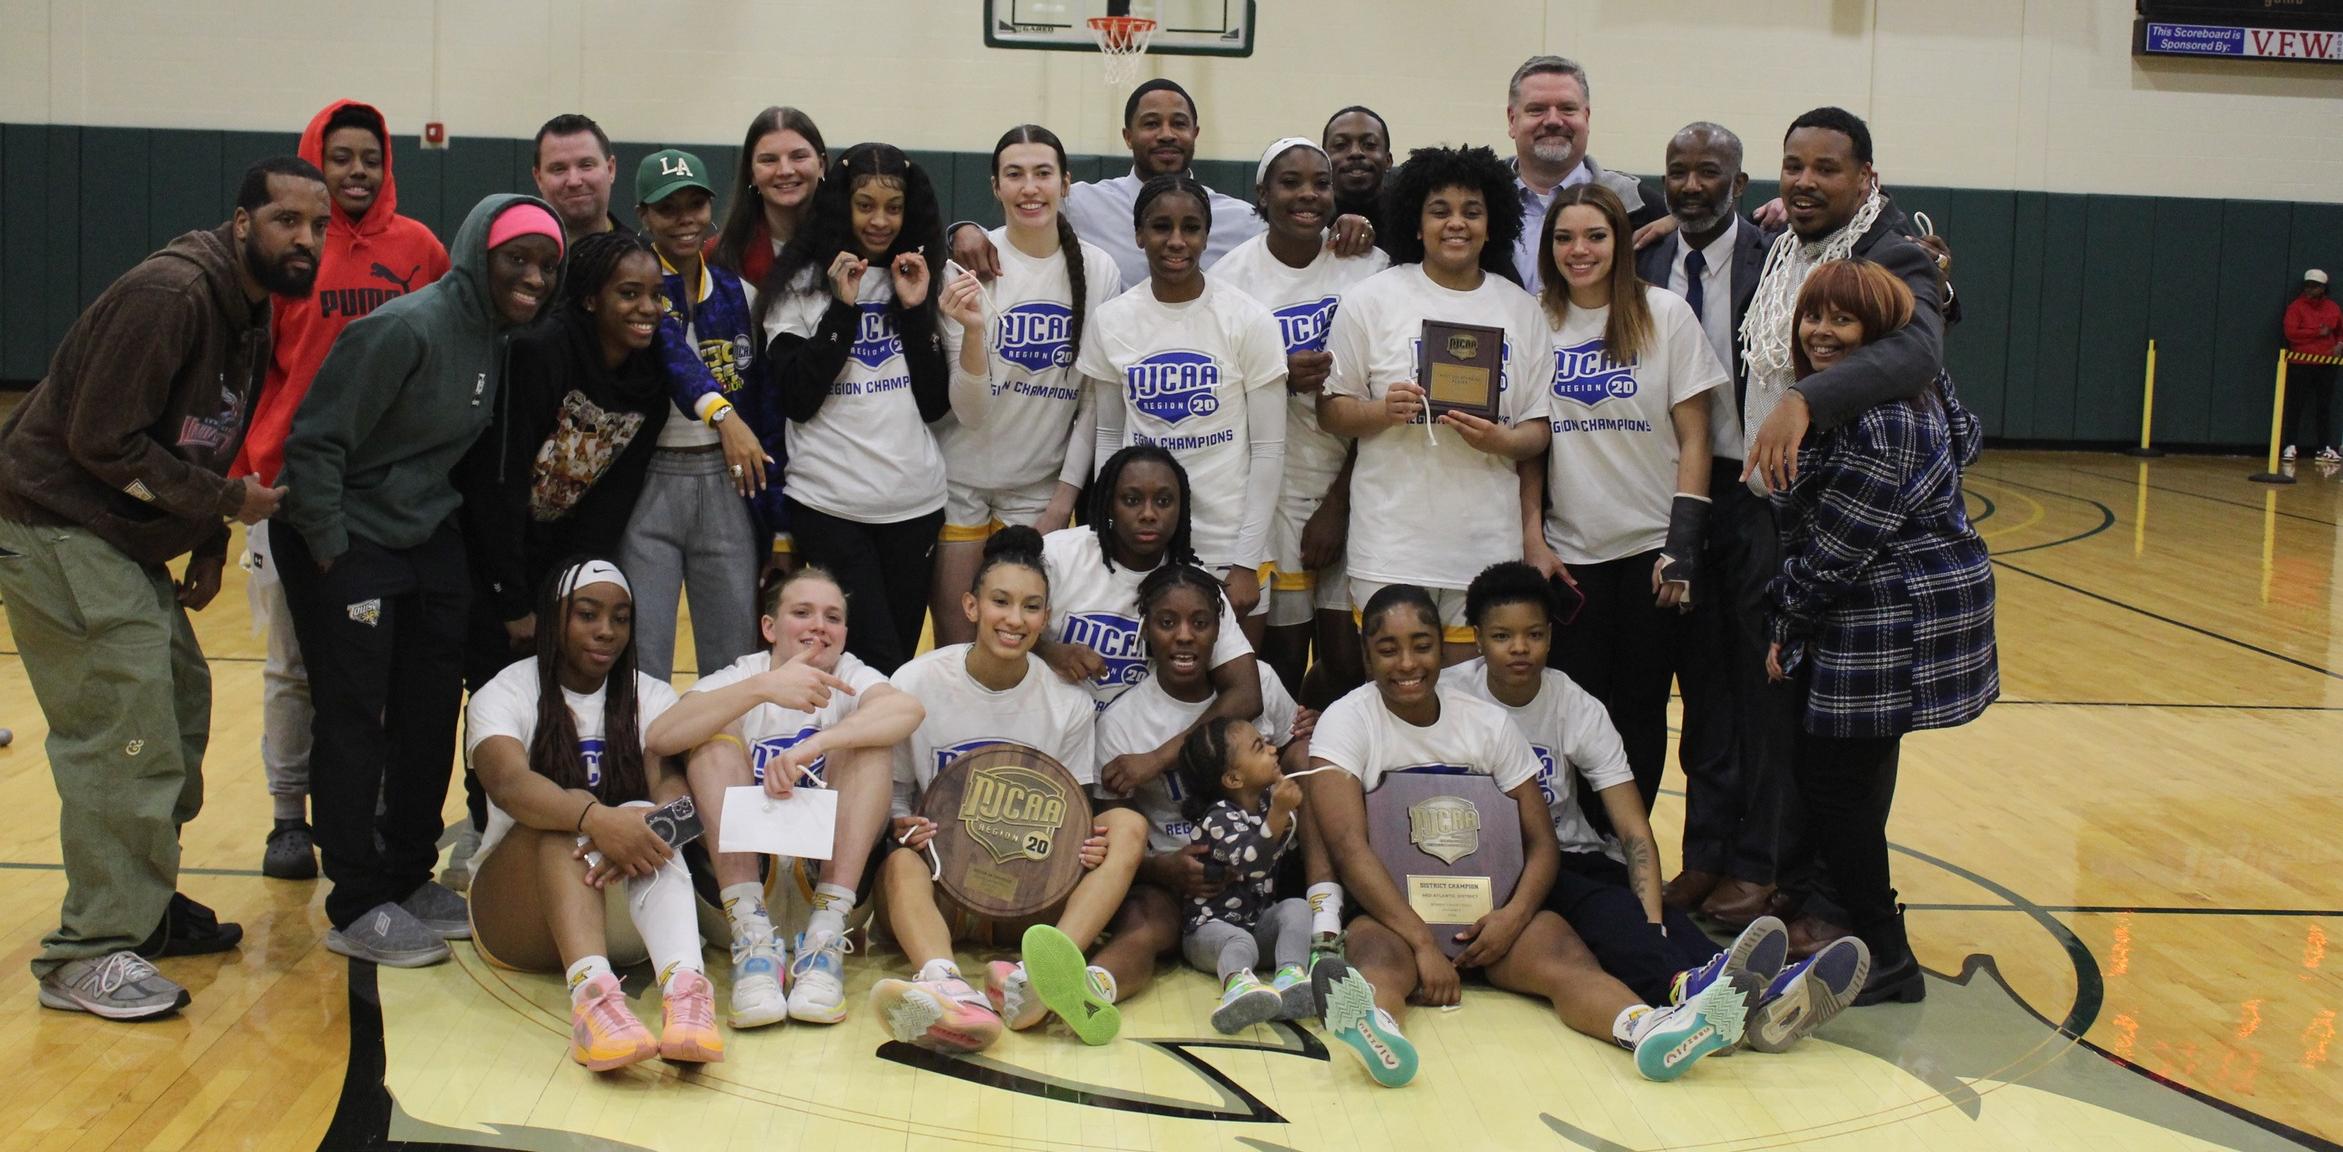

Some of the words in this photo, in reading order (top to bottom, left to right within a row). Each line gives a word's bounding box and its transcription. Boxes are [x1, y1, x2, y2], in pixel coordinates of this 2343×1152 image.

[2153, 26, 2172, 37] This
[2174, 27, 2232, 40] Scoreboard
[2232, 29, 2241, 40] is
[2160, 38, 2214, 51] Sponsored
[2215, 41, 2231, 53] By:
[2251, 30, 2333, 58] V.F.W.
[659, 156, 694, 178] LA
[320, 287, 401, 318] PUM
[850, 346, 885, 357] REGION
[1008, 350, 1048, 360] REGION
[866, 375, 909, 393] CHAMP
[1127, 364, 1218, 401] NJCAA
[1560, 384, 1602, 393] REGION
[1611, 380, 1635, 394] 20
[1013, 381, 1079, 401] CHAMPIONS
[1144, 402, 1184, 410] REGION
[1192, 399, 1216, 412] 20
[1552, 419, 1580, 434] GION
[1160, 428, 1233, 450] CHAMPIONS
[963, 775, 1062, 824] NJCAA
[978, 822, 1020, 843] REGION
[1165, 822, 1192, 836] REG
[1412, 808, 1478, 842] NJCAA
[1025, 836, 1050, 856] 20
[1419, 882, 1448, 890] DISTRICT
[1448, 882, 1480, 891] CHAMPION
